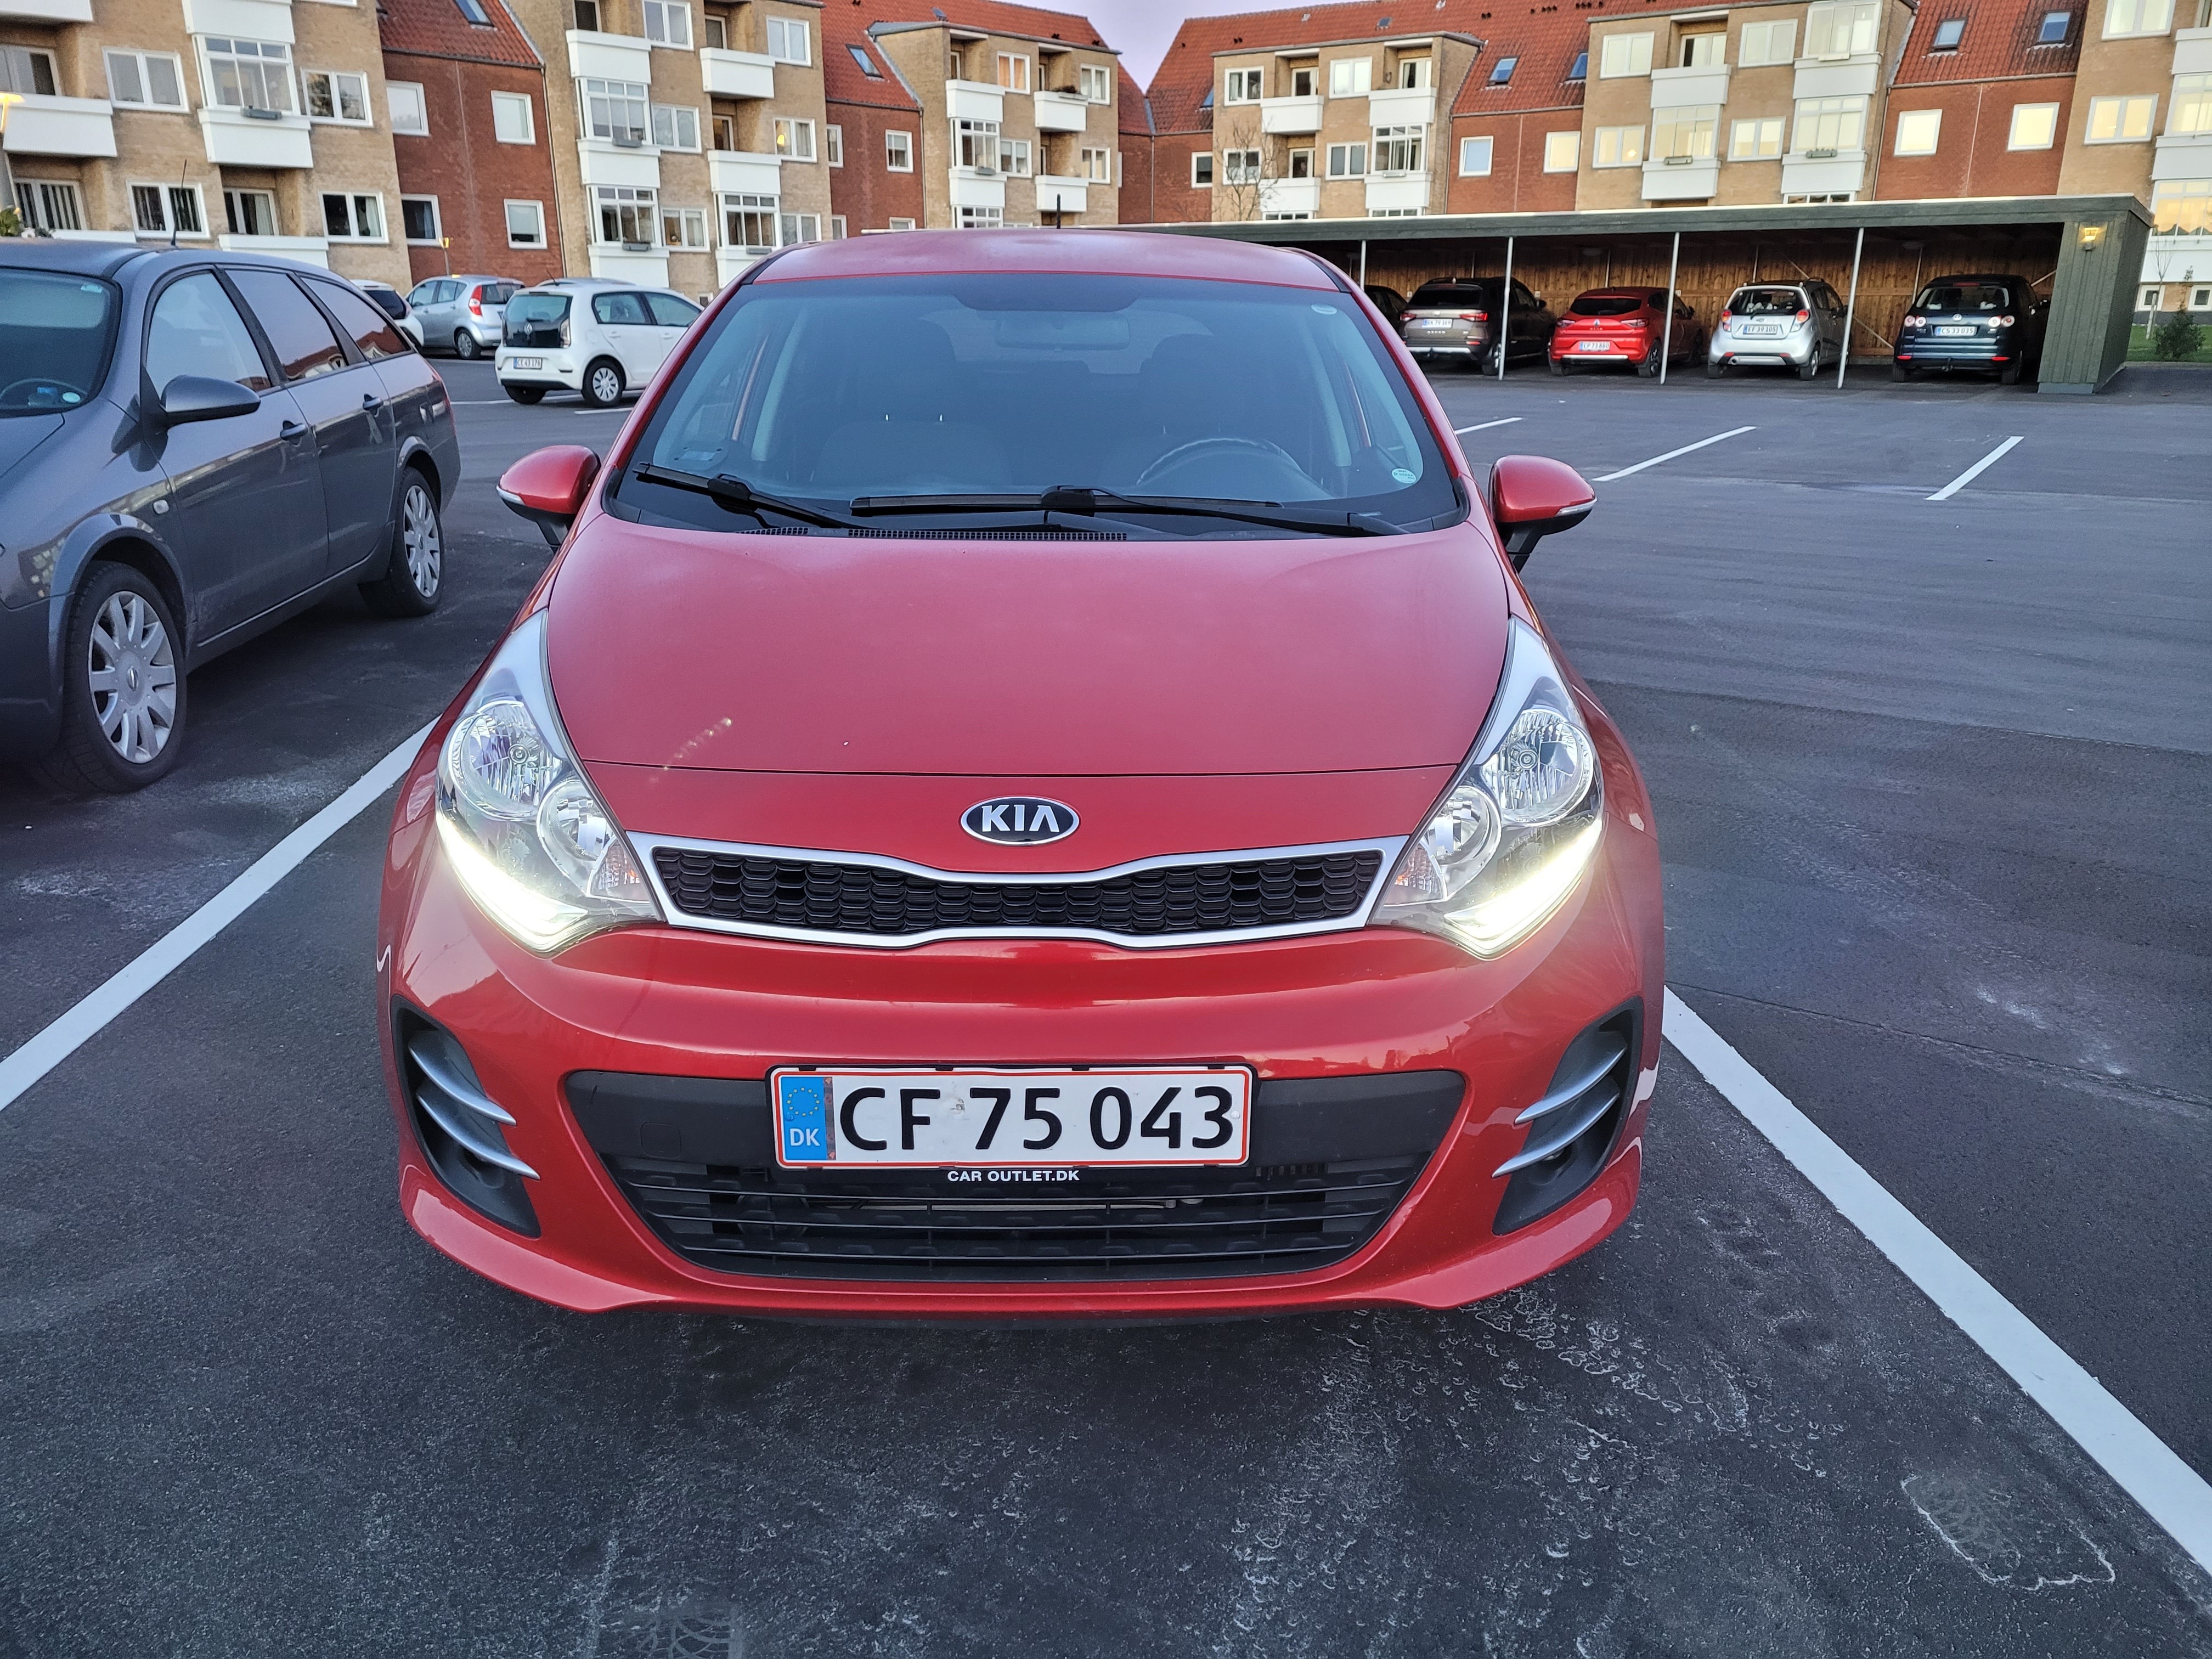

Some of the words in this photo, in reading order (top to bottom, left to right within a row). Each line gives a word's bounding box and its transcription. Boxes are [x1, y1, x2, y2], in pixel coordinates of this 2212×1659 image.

[981, 804, 1060, 833] KIA
[789, 1128, 821, 1147] DK
[840, 1087, 941, 1150] CF
[969, 1087, 1063, 1150] 75
[1090, 1086, 1233, 1150] 043
[947, 1170, 982, 1182] CAR
[987, 1170, 1080, 1182] OUTLET.DK
